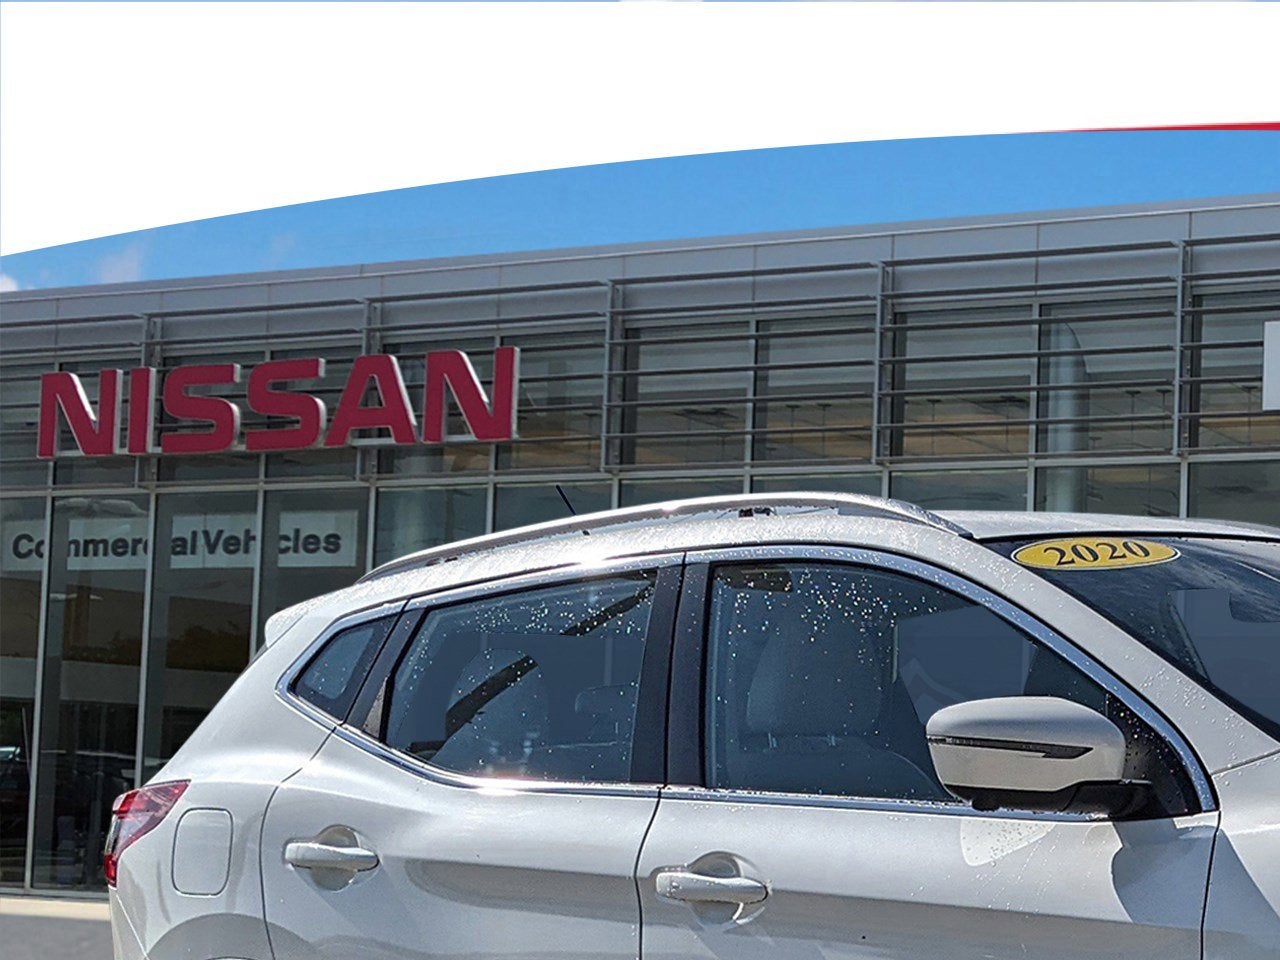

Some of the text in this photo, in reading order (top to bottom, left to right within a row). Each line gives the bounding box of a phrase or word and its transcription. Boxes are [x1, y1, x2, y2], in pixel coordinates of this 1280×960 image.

[37, 346, 520, 460] NISSAN
[201, 527, 342, 556] Vehcles
[1042, 540, 1151, 567] 2020
